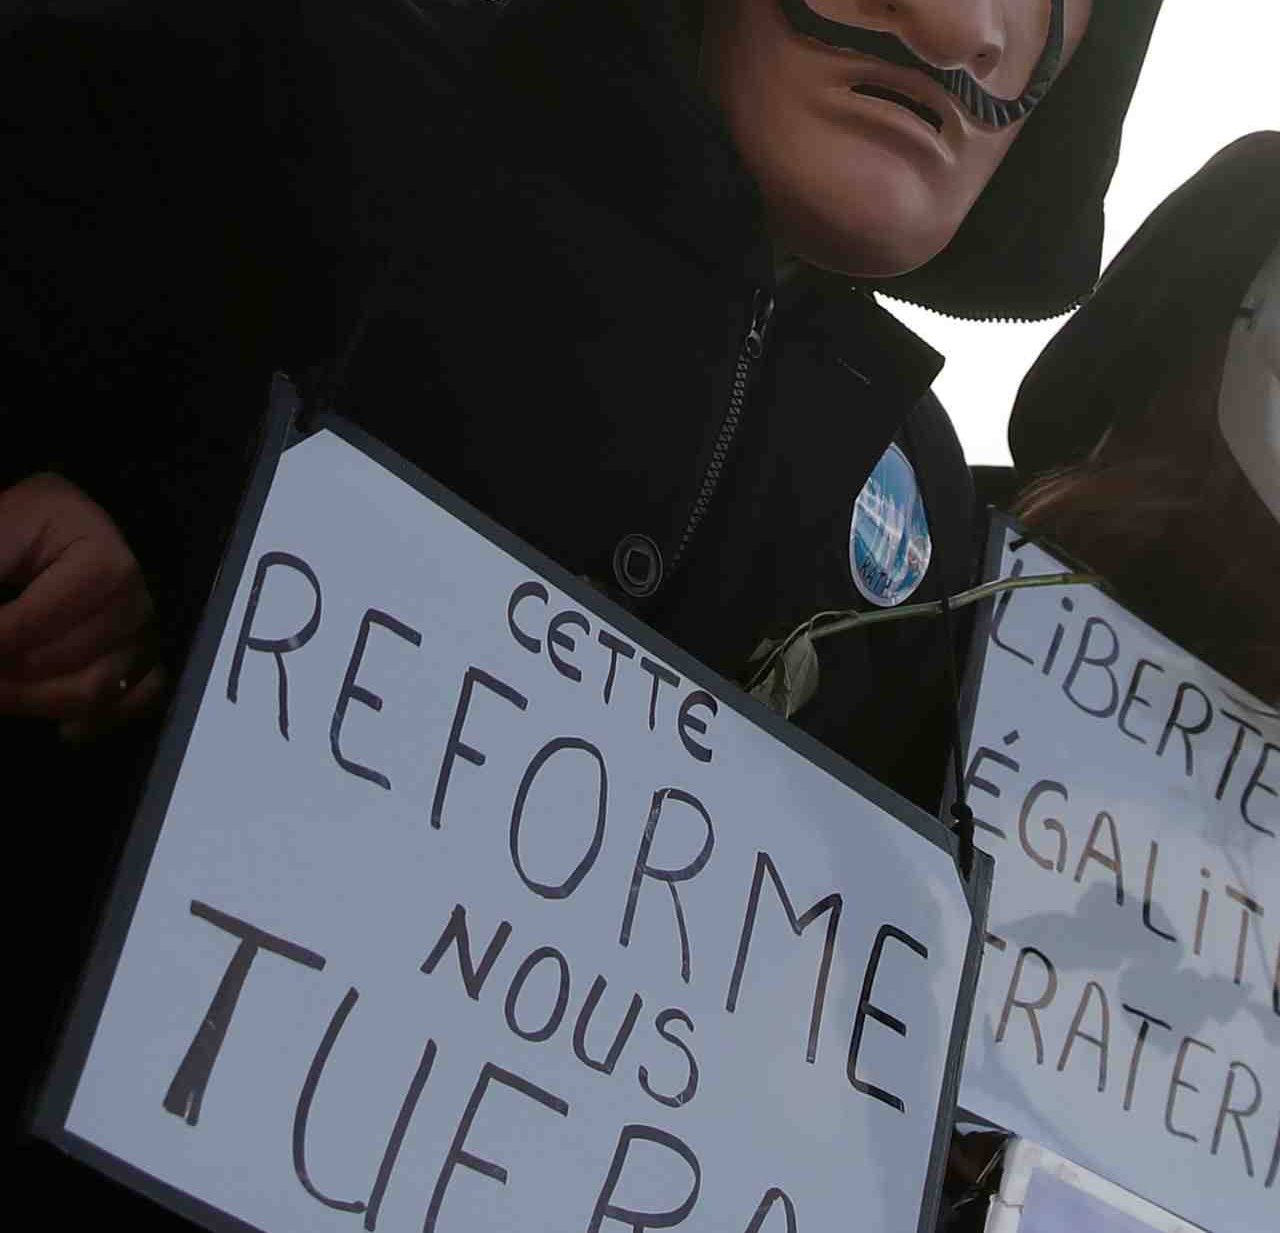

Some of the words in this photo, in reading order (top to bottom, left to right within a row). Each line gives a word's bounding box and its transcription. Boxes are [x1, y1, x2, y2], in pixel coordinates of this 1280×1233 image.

[506, 580, 720, 764] CETTE
[226, 549, 930, 1115] REFORME
[419, 903, 701, 1109] NOUS
